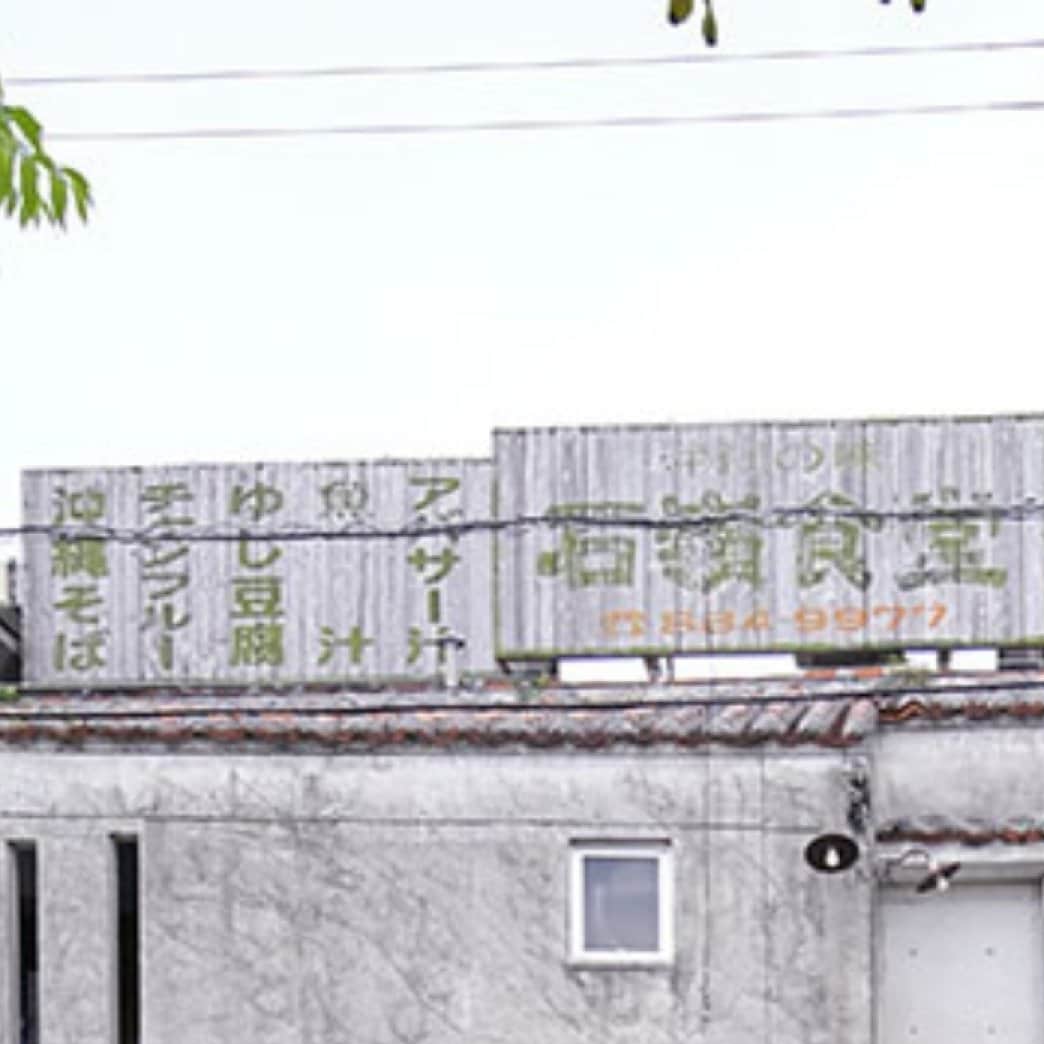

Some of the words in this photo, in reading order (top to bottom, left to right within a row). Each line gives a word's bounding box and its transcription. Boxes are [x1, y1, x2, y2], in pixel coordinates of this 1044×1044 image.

[52, 487, 109, 672] 沖縄そば
[229, 482, 284, 666] ゆし豆腐
[537, 489, 1008, 593] 石嶺食堂
